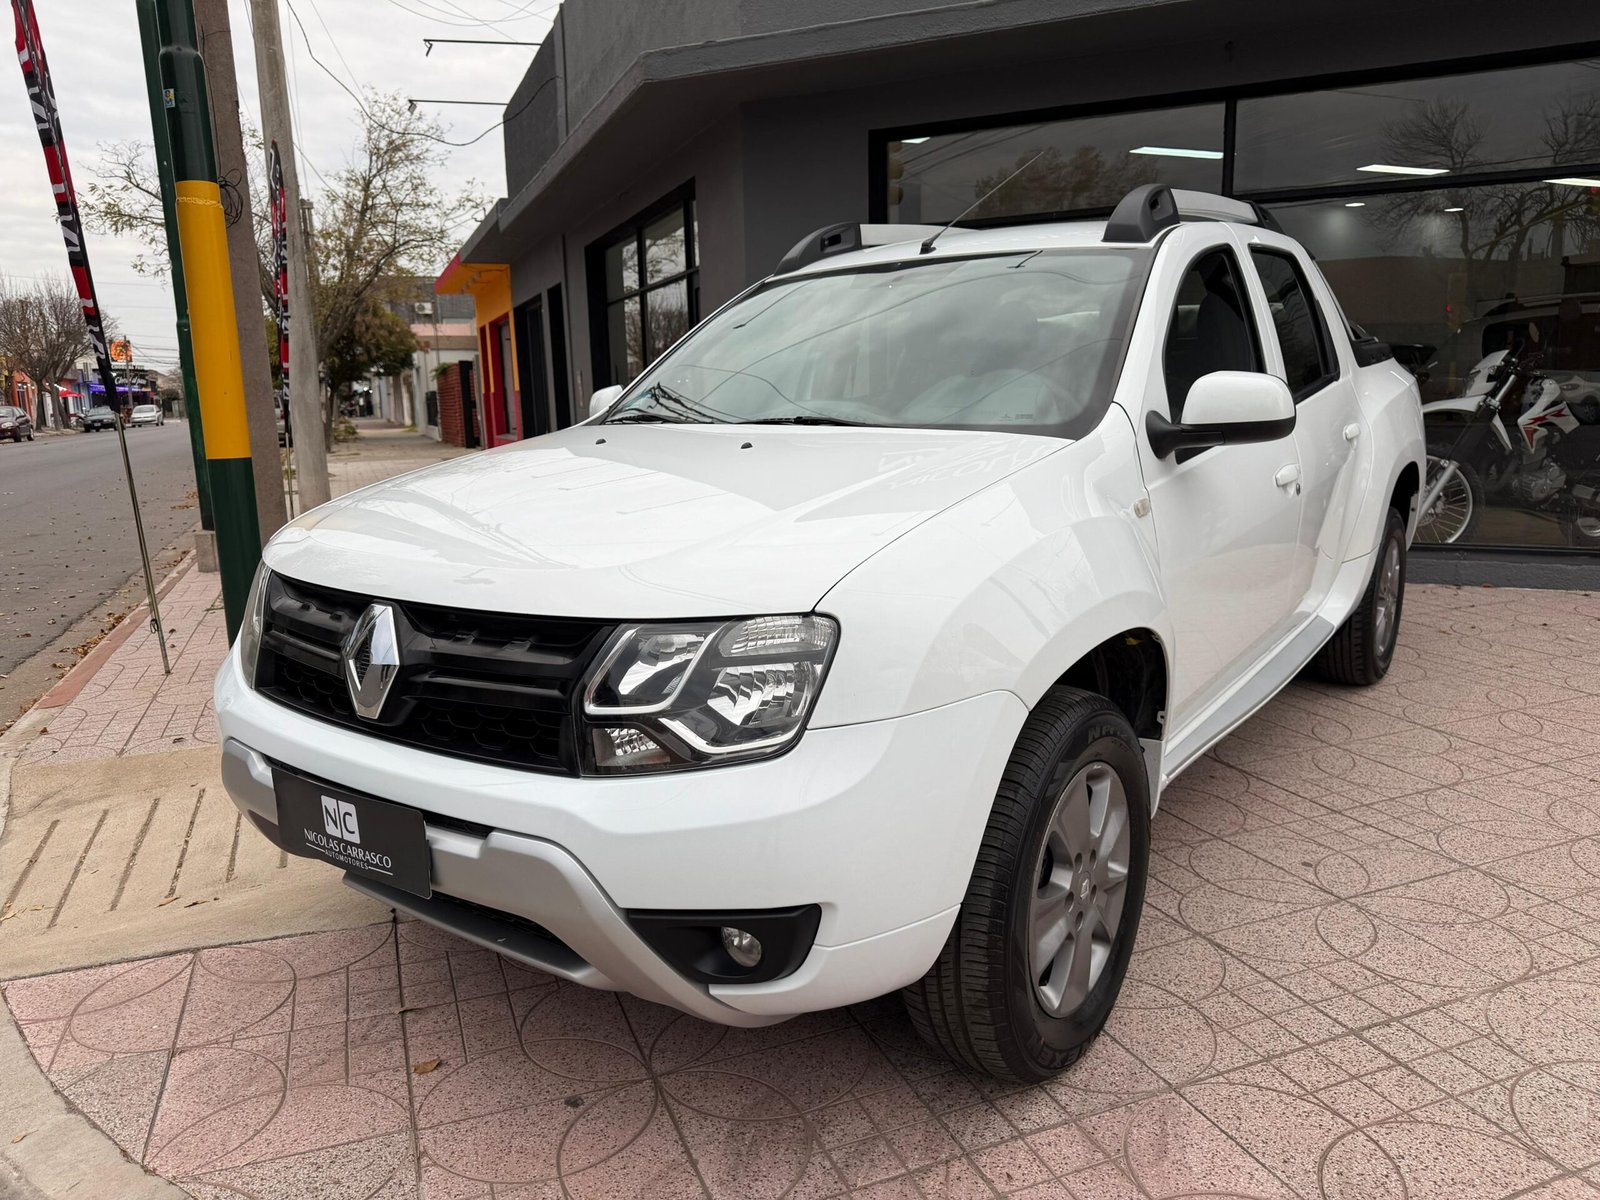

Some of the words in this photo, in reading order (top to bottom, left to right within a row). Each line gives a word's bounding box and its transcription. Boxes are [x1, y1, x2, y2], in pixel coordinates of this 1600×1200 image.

[324, 804, 356, 835] NC
[303, 828, 340, 852] NICOLAS
[340, 843, 392, 869] CARRASCO
[325, 850, 369, 871] AUTOMOTORES
